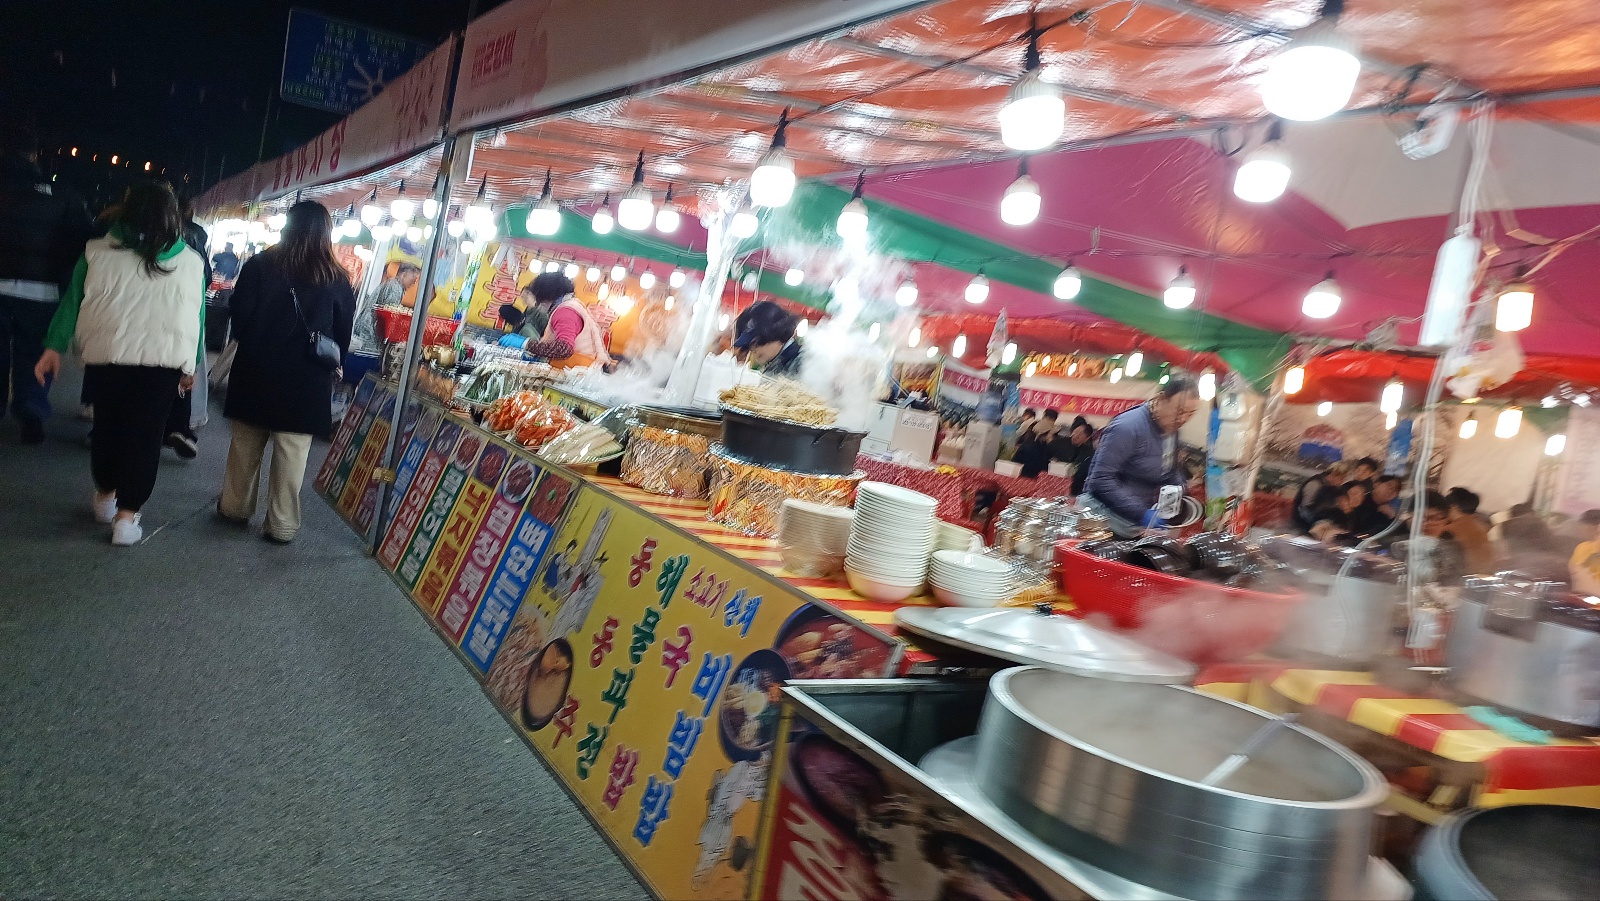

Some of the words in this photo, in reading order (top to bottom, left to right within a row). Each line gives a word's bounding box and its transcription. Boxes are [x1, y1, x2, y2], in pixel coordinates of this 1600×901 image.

[383, 455, 441, 565] 순대야채볶음
[418, 482, 488, 609] 낙지볶음
[441, 499, 517, 635] 곱창볶음
[468, 517, 549, 664] 뼈없는닭발
[552, 536, 658, 750] 동동주
[683, 565, 730, 619] 소고기
[723, 587, 762, 638] 산채
[576, 553, 691, 780] 해물파전
[602, 624, 694, 811] 국밥
[633, 651, 732, 847] 비빔밥
